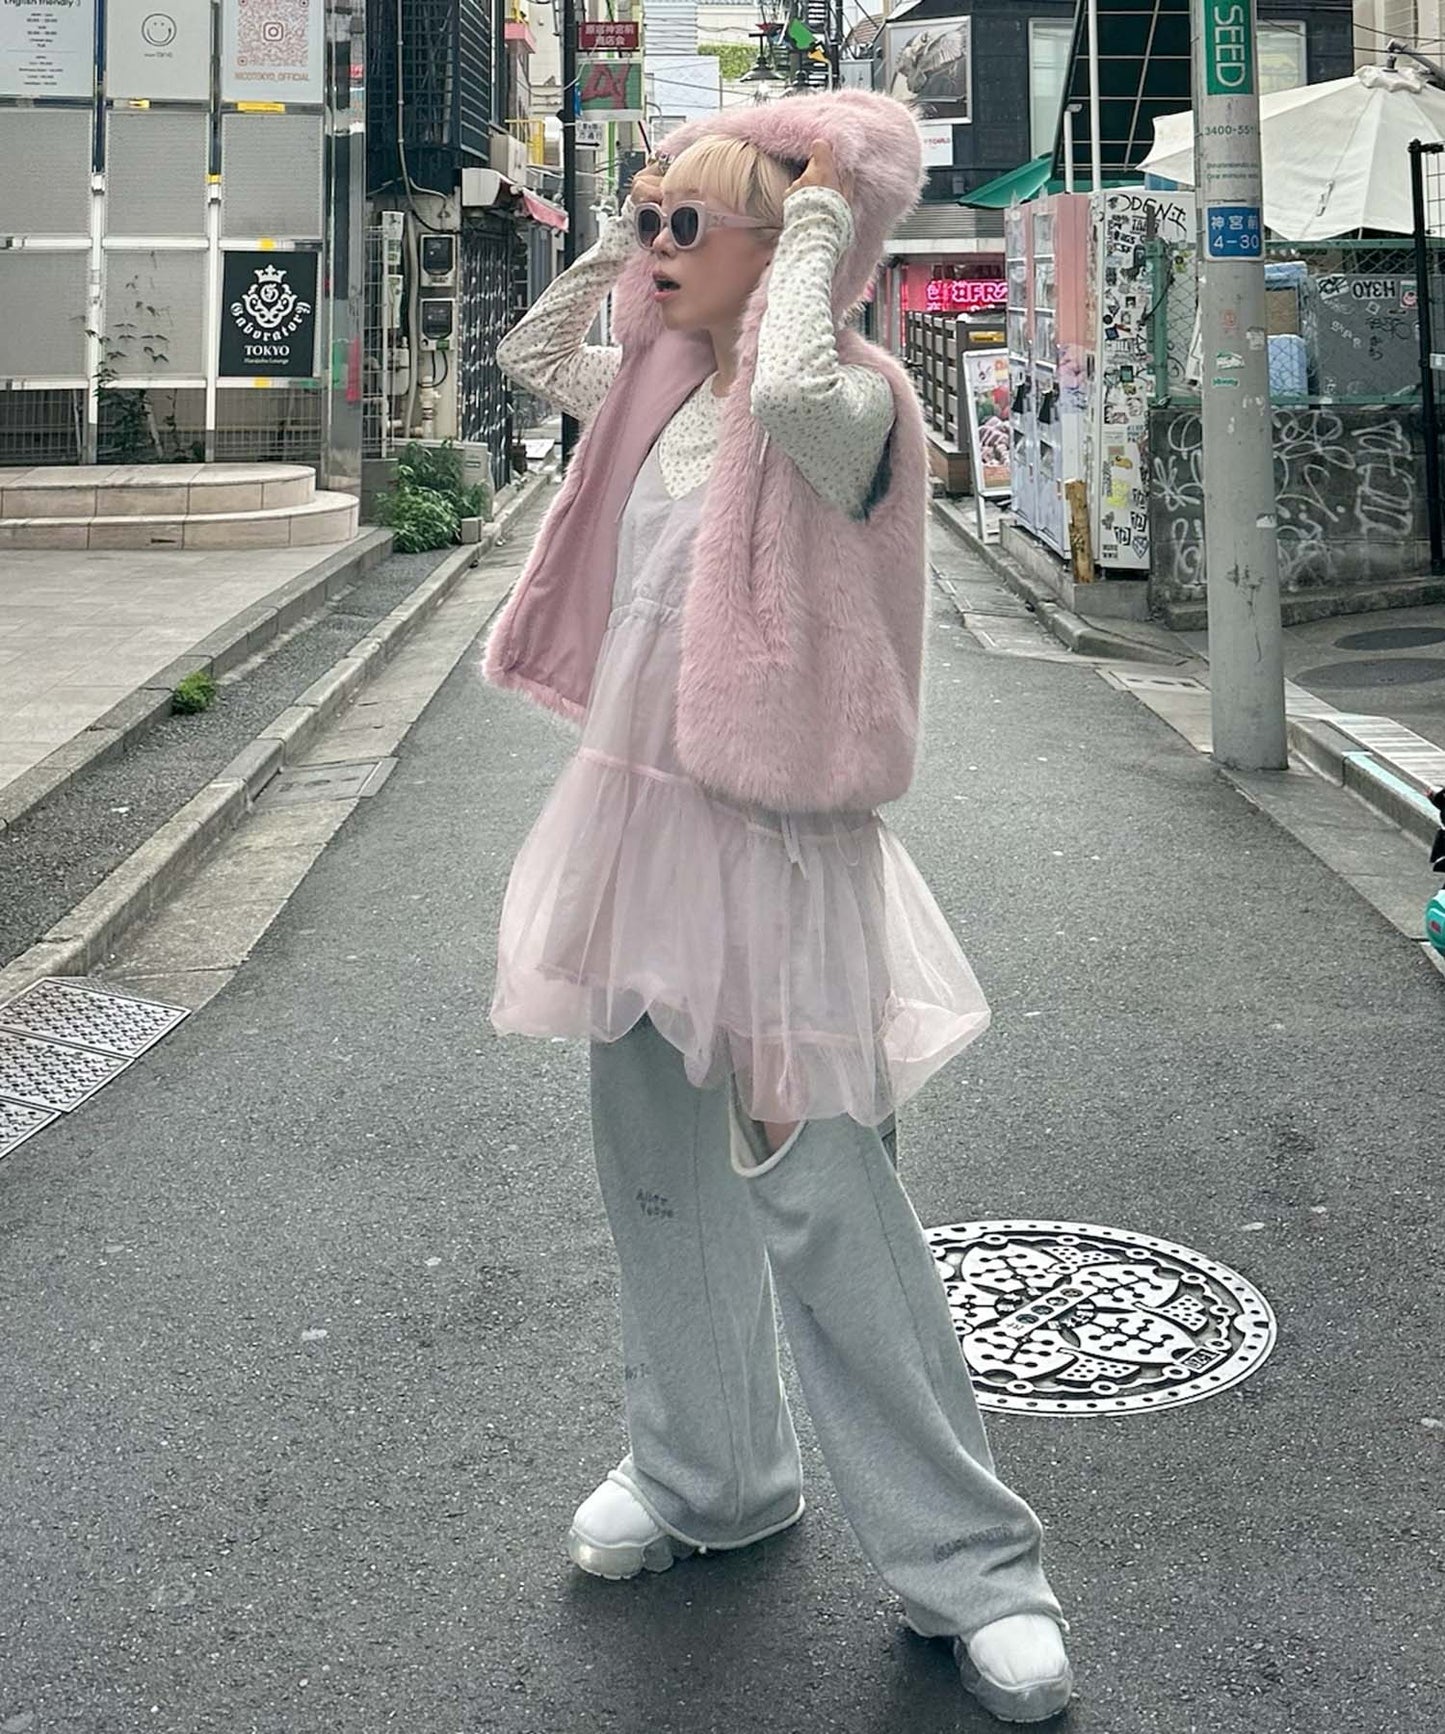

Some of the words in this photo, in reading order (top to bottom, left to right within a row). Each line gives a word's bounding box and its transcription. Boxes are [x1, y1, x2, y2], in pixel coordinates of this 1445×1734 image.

[1214, 5, 1245, 87] SEED
[1211, 215, 1258, 230] 神宮前
[1213, 234, 1260, 250] 4-30
[244, 345, 290, 356] TOKYO
